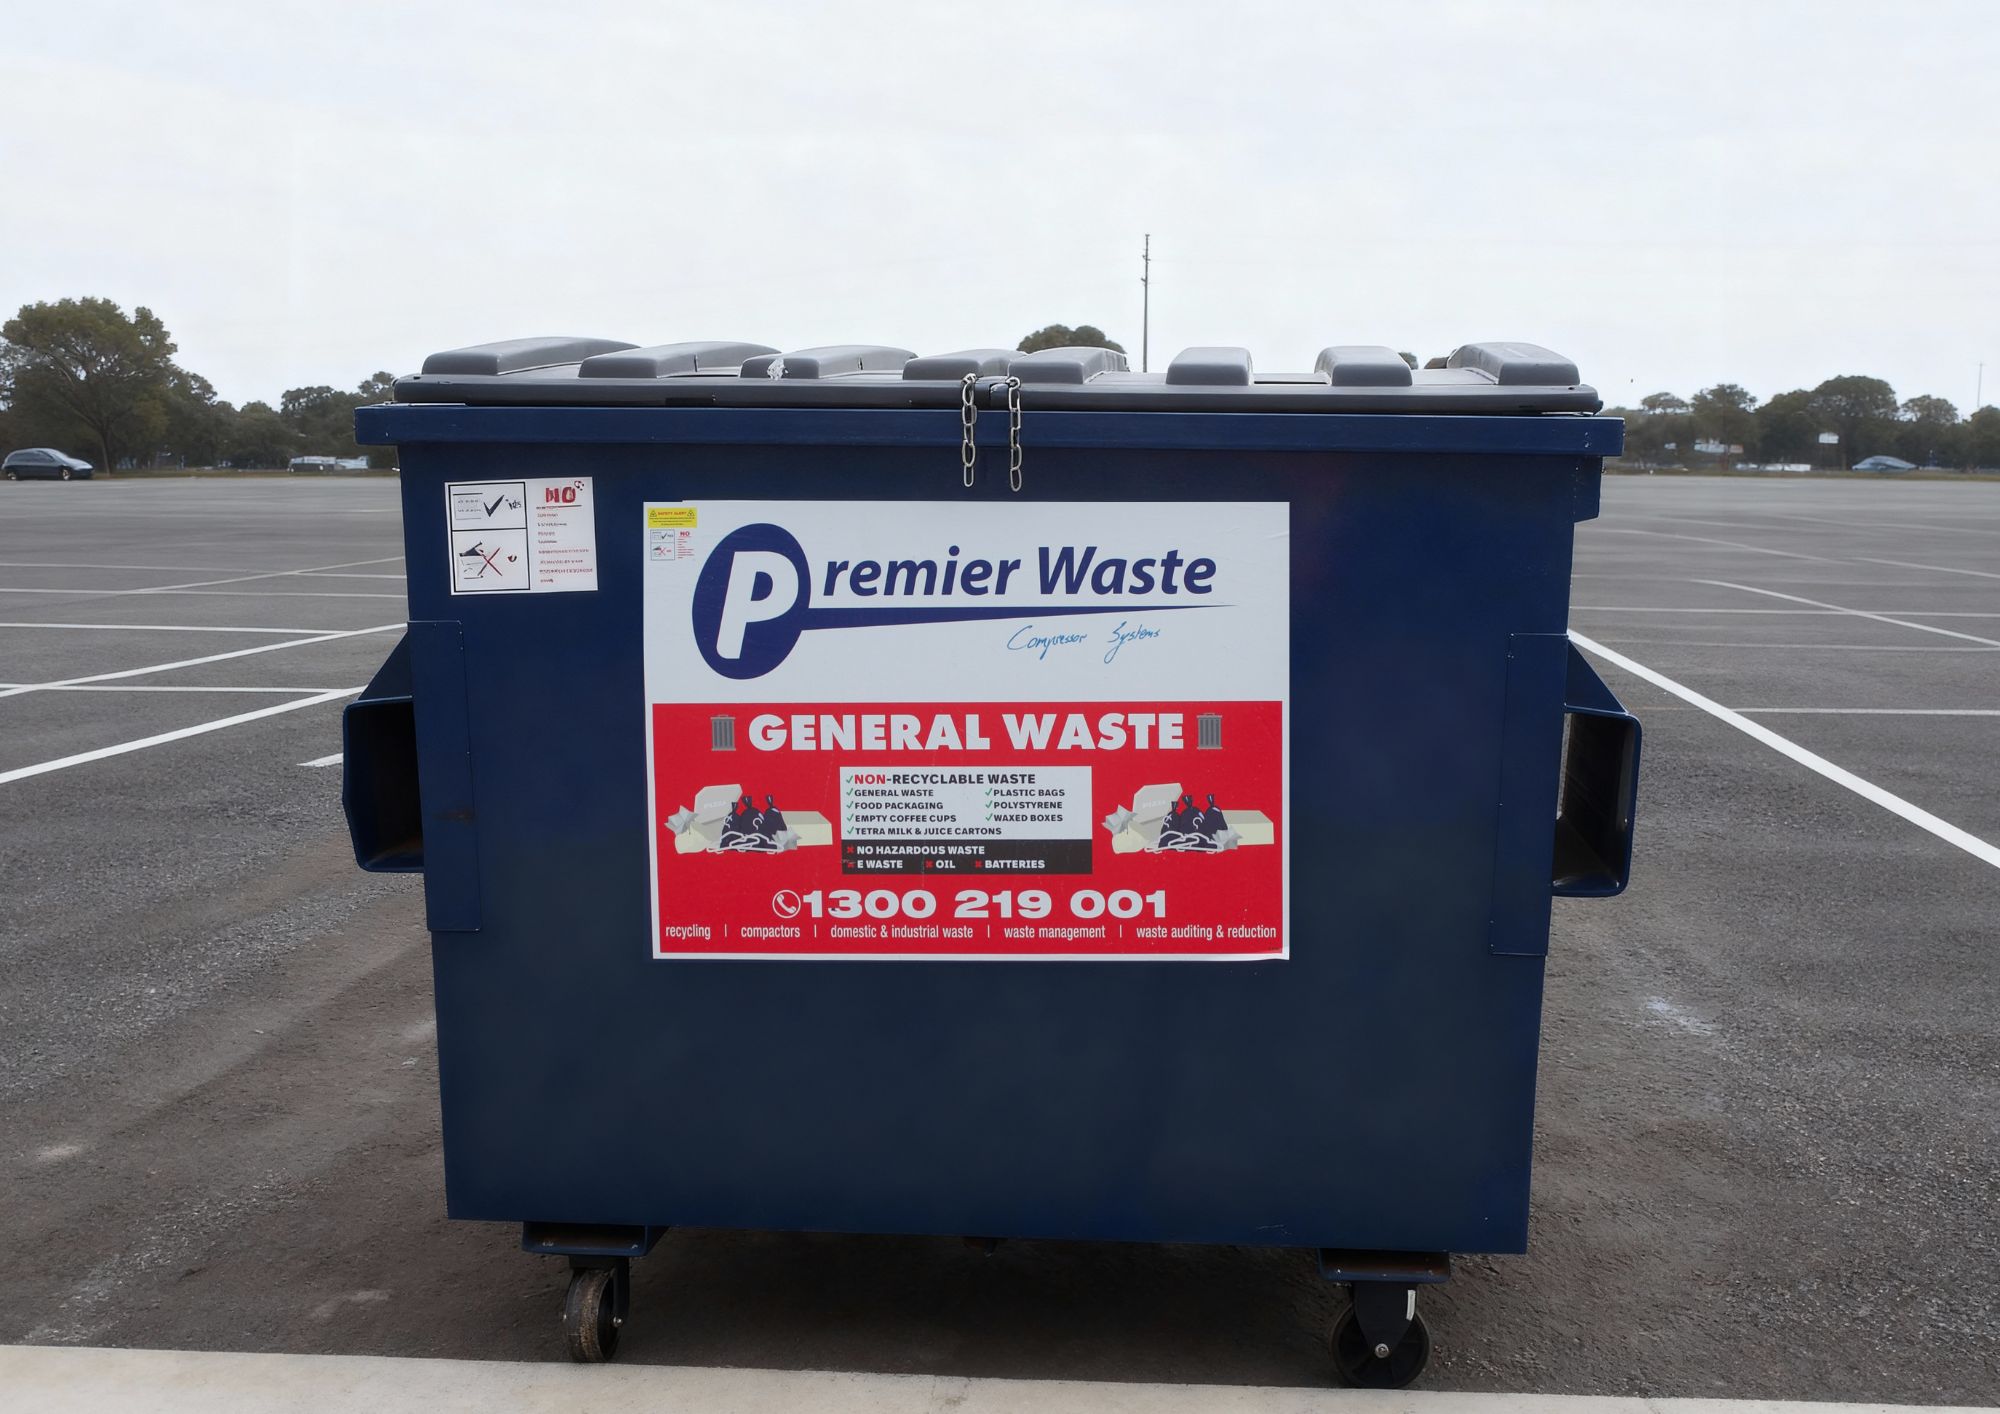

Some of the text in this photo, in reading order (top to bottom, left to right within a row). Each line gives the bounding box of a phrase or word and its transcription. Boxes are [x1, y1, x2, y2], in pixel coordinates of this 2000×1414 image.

[1038, 546, 1216, 595] Waste
[1104, 621, 1160, 664] Systems
[748, 713, 1184, 751] GENERAL WASTE
[854, 773, 1036, 785] NON-RECYCLABLE WASTE
[854, 789, 934, 797] GENERAL WASTE
[993, 789, 1065, 797] PLASTIC BAGS
[993, 801, 1062, 809] POLYSTYRENE
[855, 815, 957, 823] EMPTY COFFEE CUPS
[994, 814, 1063, 822] WAXED BOXES
[888, 827, 912, 835] MILK
[924, 827, 953, 835] JUICE
[955, 827, 1002, 835] CARTONS
[857, 845, 985, 854] NO HAZARDOUS WASTE
[857, 860, 903, 868] E WASTE
[936, 860, 956, 868] OIL
[985, 860, 1045, 868] BATTERIES
[803, 889, 1166, 918] 1300 219 001
[665, 925, 711, 939] recycling
[741, 925, 801, 939] compactors
[830, 925, 973, 938] domestic & industrial waste
[1004, 927, 1106, 940] waste management
[1136, 925, 1277, 940] waste auditing & reduction
